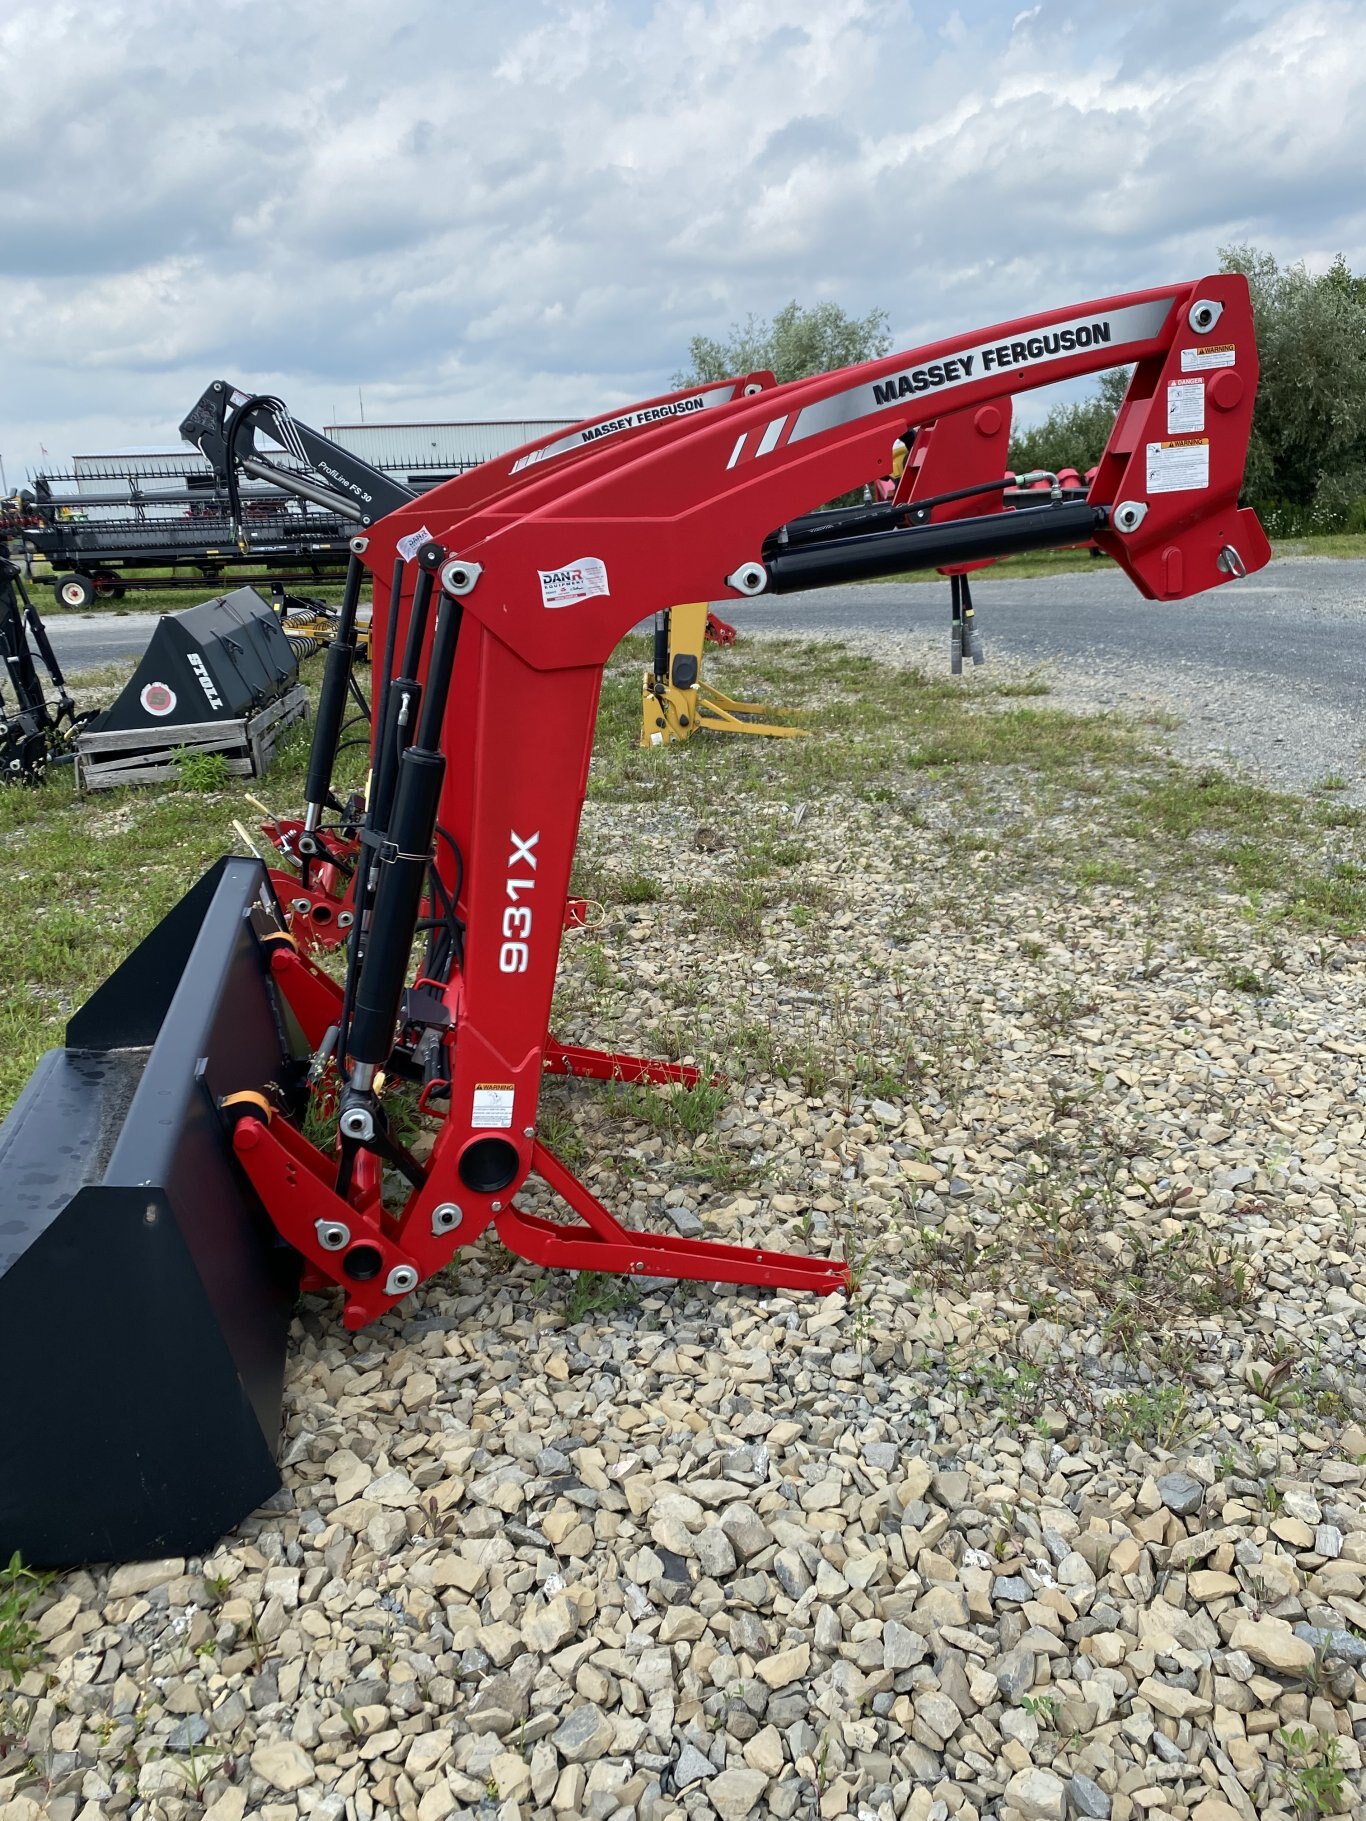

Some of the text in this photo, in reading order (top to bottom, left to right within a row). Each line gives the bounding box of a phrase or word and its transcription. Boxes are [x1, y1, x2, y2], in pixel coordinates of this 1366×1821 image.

[1204, 345, 1234, 354] WARNING
[873, 321, 1111, 405] MASSEY FERGUSON
[1177, 377, 1203, 386] DANGER
[582, 397, 704, 443] MASSEY FERGUSON
[1174, 439, 1203, 448] WARNING
[318, 461, 372, 503] ProfiLine FS 30
[543, 569, 583, 584] DANR
[544, 580, 584, 590] EQUIPMENT
[187, 653, 223, 709] STOLL
